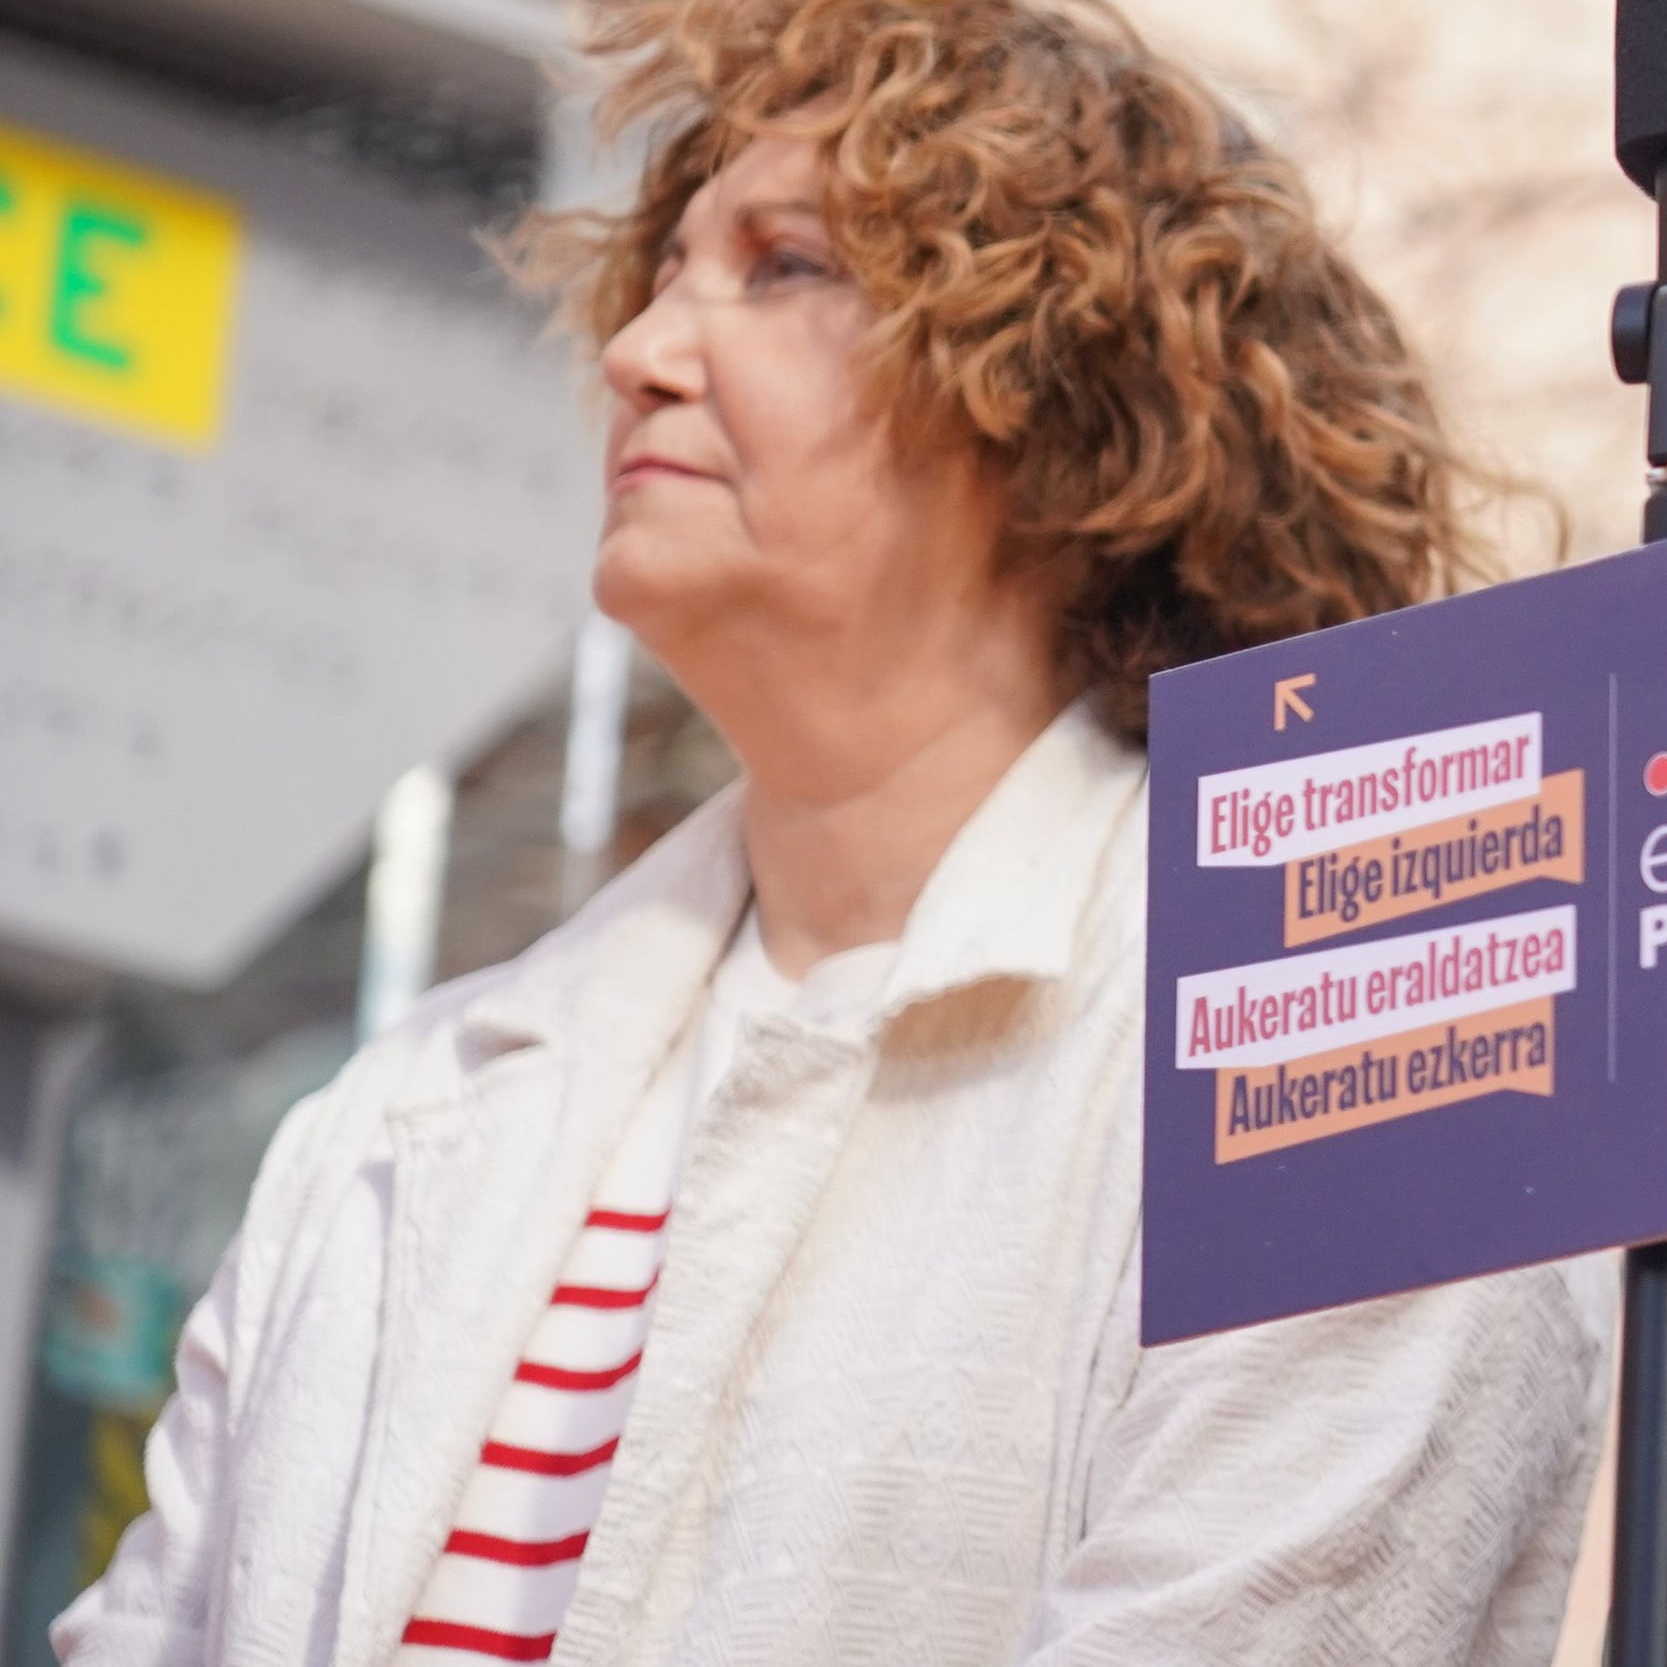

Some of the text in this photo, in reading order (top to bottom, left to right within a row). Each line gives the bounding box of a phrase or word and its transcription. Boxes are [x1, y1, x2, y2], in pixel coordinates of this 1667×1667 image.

[0, 178, 143, 370] E
[1210, 734, 1530, 858] Elige transformar
[1298, 804, 1563, 923] Elige izquierda
[1188, 927, 1565, 1058] Aukeratu eraldatzea
[1228, 1021, 1547, 1136] Aukeratu ezkerra
